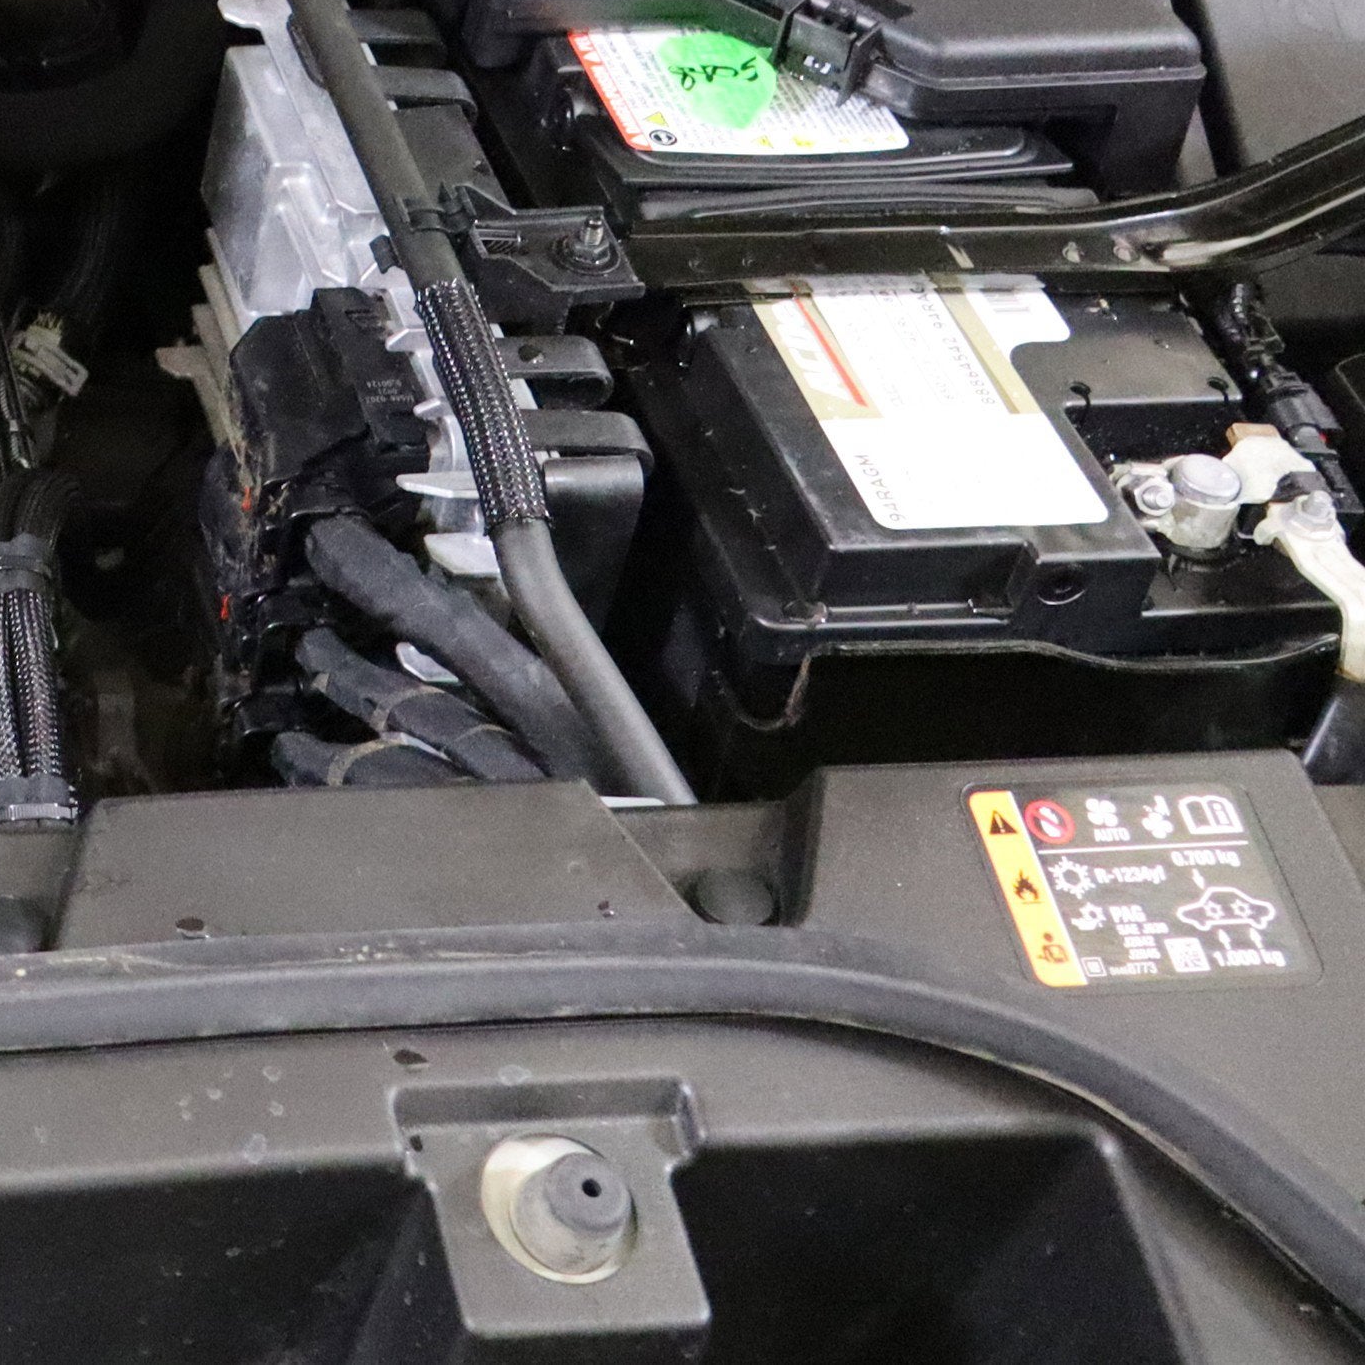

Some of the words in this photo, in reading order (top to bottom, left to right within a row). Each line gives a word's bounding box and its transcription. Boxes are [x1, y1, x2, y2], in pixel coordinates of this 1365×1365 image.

[853, 453, 907, 523] 94RAGM
[1094, 826, 1131, 843] AUTO
[1218, 849, 1241, 868] kg
[1108, 905, 1147, 924] PAG
[1261, 947, 1287, 968] kg
